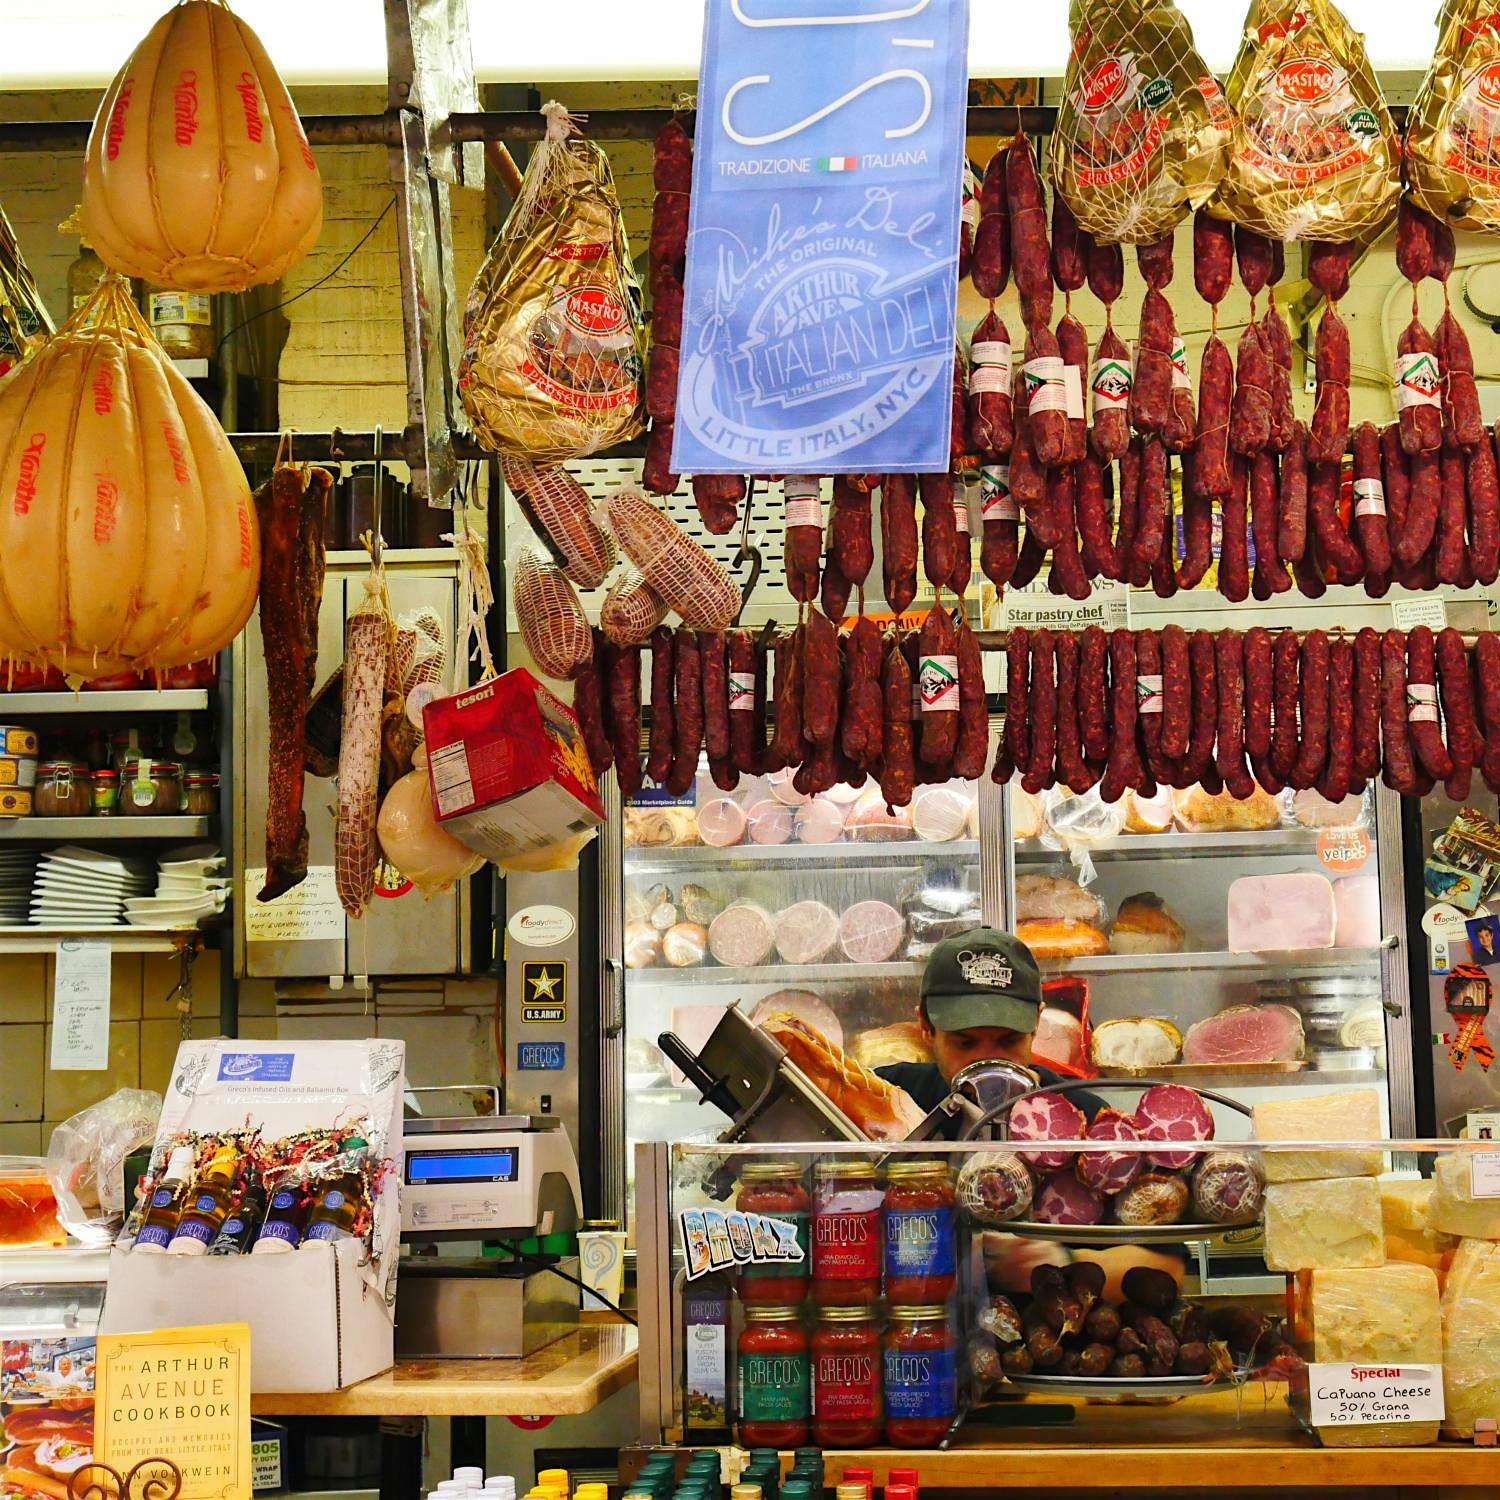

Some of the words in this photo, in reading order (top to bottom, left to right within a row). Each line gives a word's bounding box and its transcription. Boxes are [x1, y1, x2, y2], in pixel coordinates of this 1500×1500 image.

[1084, 65, 1122, 101] MASTRO
[1279, 71, 1335, 89] MASTRO
[1358, 113, 1371, 122] ALL
[718, 158, 812, 177] TRADIZIONE
[861, 151, 929, 169] ITALIANA
[1251, 154, 1358, 181] PROSCIUTTO
[756, 260, 786, 292] THE
[791, 237, 878, 264] ORIGINAL
[569, 296, 623, 322] MASTRO
[773, 270, 860, 332] ARTHUR
[763, 309, 879, 388] ITALIAN
[700, 416, 792, 457] LITTLE
[800, 412, 876, 453] ITALY,
[876, 366, 927, 420] NYC
[1007, 608, 1033, 621] Star
[1035, 606, 1073, 622] pastry
[1076, 605, 1103, 618] chef
[455, 686, 496, 710] tesori
[1323, 847, 1352, 862] yelp
[522, 1047, 560, 1065] GRECO'S
[139, 1229, 168, 1245] GRECO'S
[180, 1222, 208, 1239] GRECO'S
[816, 1217, 868, 1242] GRECO'S
[887, 1215, 938, 1241] GRECO'S
[682, 1209, 804, 1279] BRONX
[690, 1302, 721, 1317] GRECO'S
[114, 1365, 134, 1373] THE
[140, 1356, 230, 1374] ARTHUR
[750, 1359, 801, 1385] GRECO'S
[819, 1357, 871, 1383] GRECO'S
[120, 1378, 225, 1401] AVENUE
[1383, 1386, 1431, 1398] Cheese
[113, 1403, 232, 1422] COOKBOOK
[1330, 1412, 1355, 1422] 50%
[1361, 1412, 1411, 1421] Pecorino
[1340, 1402, 1366, 1412] 50%
[1372, 1401, 1409, 1411] Grana
[256, 1465, 279, 1473] WRAP
[260, 1455, 279, 1463] DUTY
